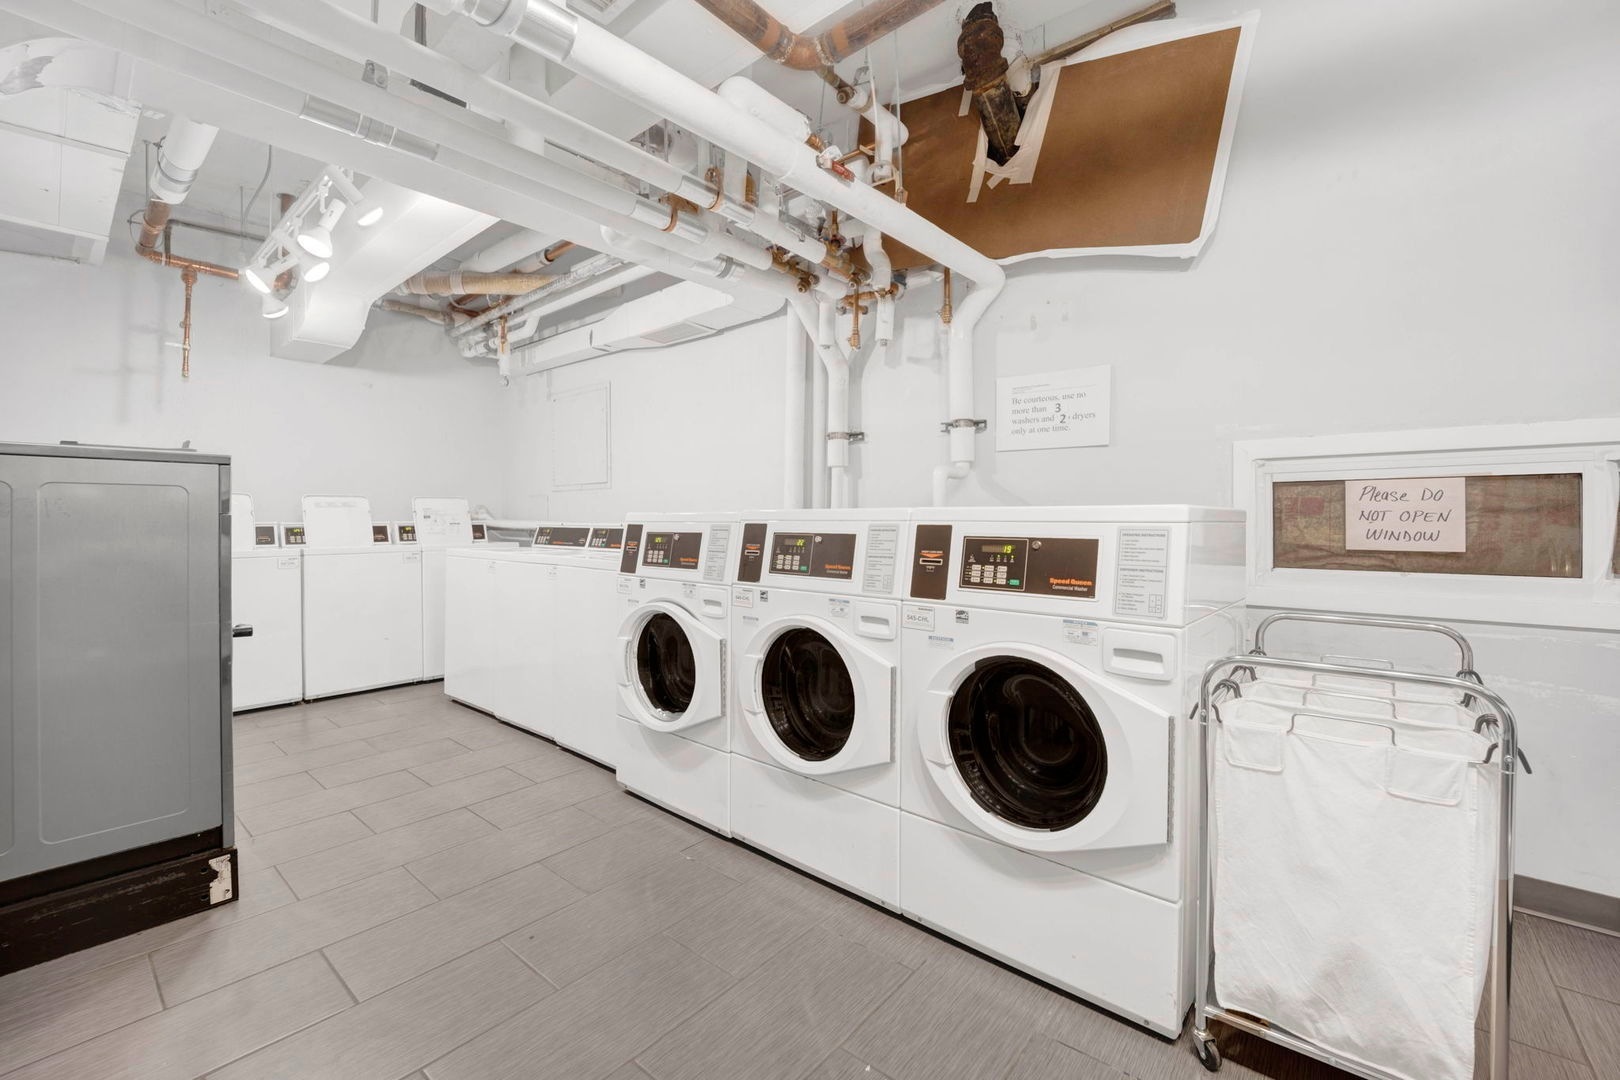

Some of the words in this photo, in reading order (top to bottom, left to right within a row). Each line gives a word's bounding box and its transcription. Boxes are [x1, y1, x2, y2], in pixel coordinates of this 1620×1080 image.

[1012, 397, 1022, 405] Be
[1062, 393, 1075, 401] use
[1076, 391, 1087, 399] no
[1011, 407, 1030, 415] more
[1031, 405, 1047, 414] than
[1054, 402, 1062, 413] 3
[1011, 415, 1040, 425] washers
[1040, 414, 1055, 423] and
[1059, 413, 1067, 424] 2
[1072, 412, 1096, 423] dryers
[1011, 426, 1026, 436] only
[1028, 425, 1035, 433] at
[1036, 426, 1051, 434] one
[1359, 485, 1409, 502] Please
[1421, 487, 1444, 502] DO
[1359, 509, 1393, 523] NOT
[1400, 509, 1452, 523] OPEN
[1366, 528, 1441, 542] WINDOW
[1003, 545, 1012, 554] 19
[1049, 577, 1070, 585] Speed
